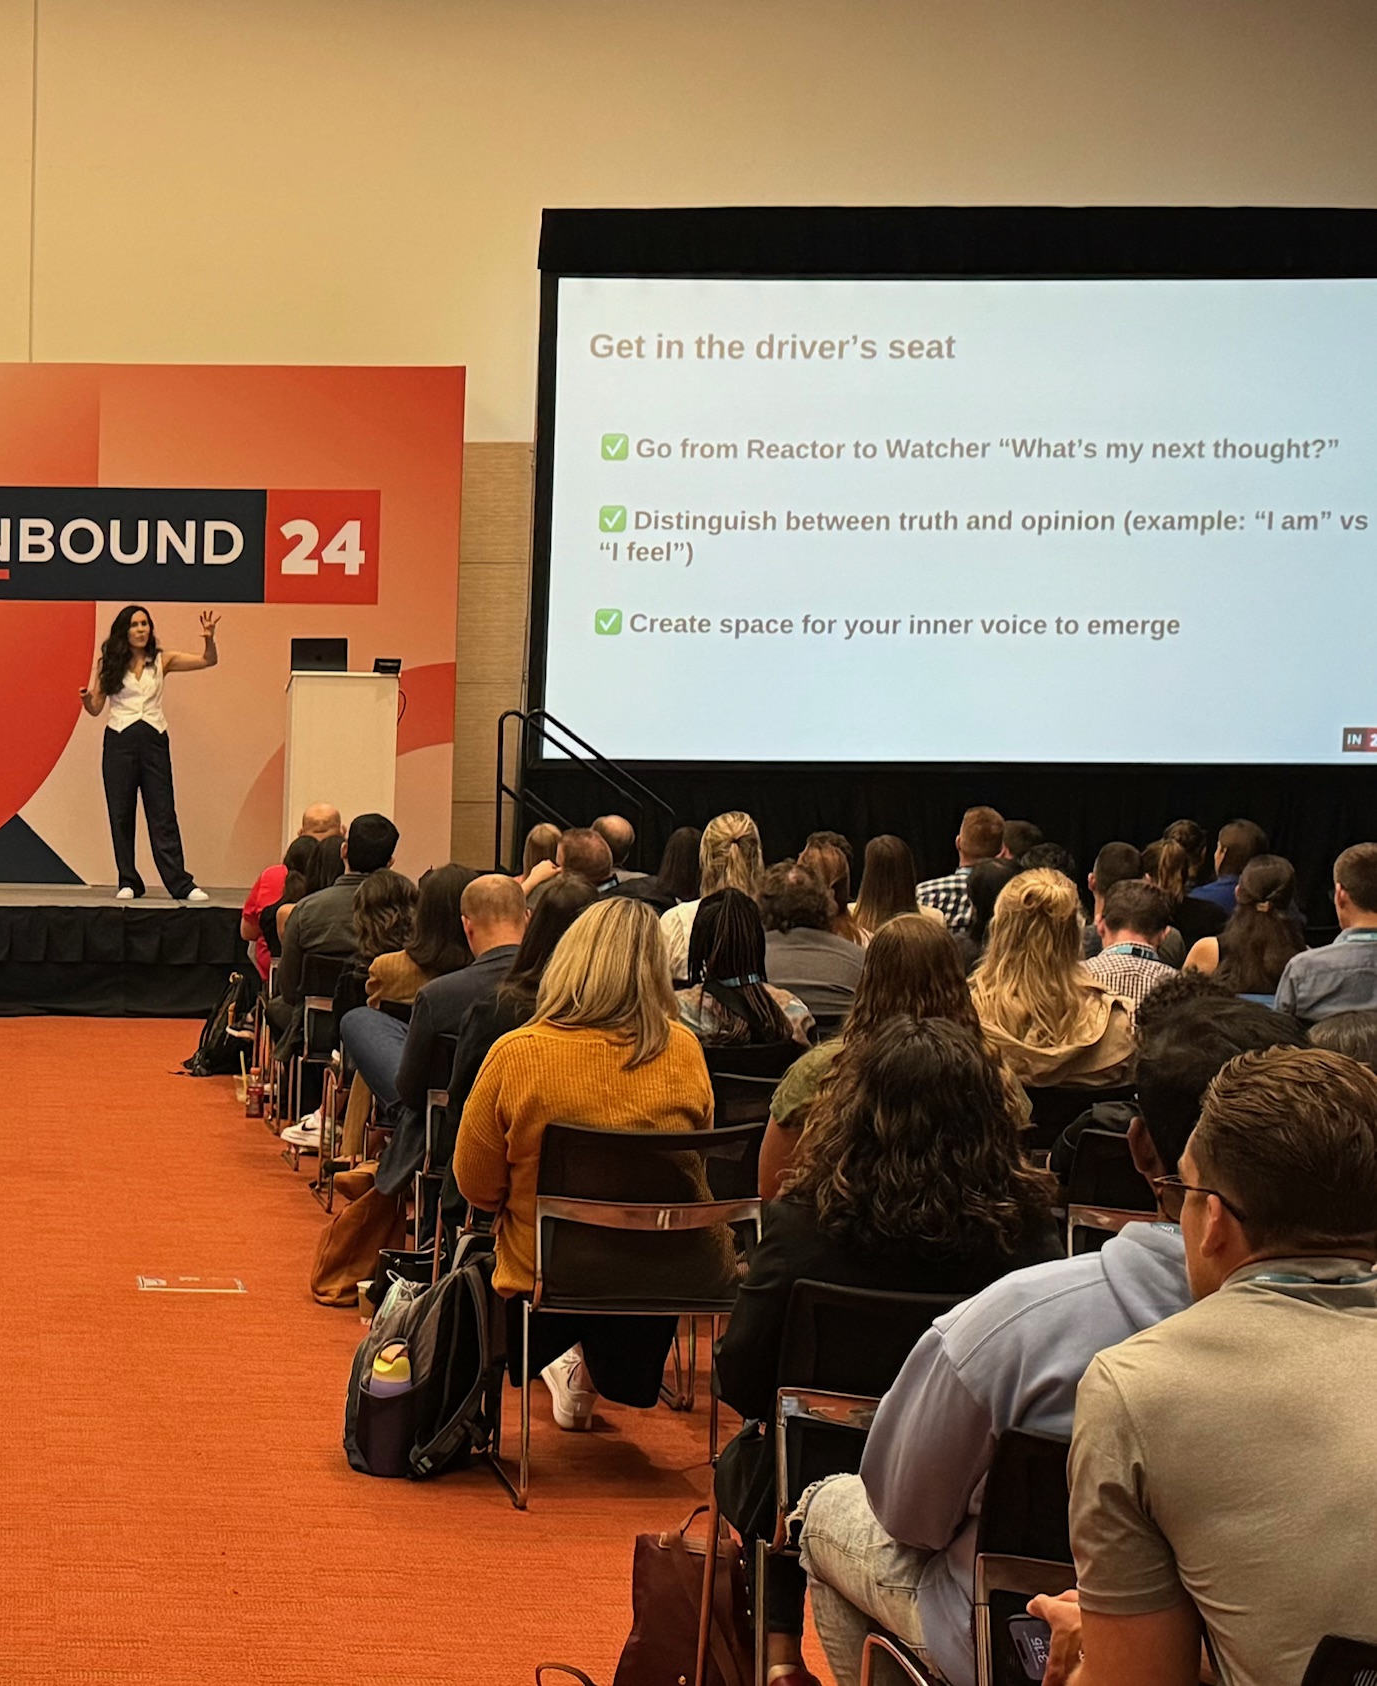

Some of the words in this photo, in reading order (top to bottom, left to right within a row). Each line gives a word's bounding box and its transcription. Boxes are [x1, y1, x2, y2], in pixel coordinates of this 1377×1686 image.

[589, 333, 646, 359] Get
[656, 333, 684, 360] in
[694, 333, 745, 360] the
[755, 333, 878, 360] driver’s
[888, 335, 957, 360] seat
[636, 438, 672, 459] Go
[680, 437, 738, 459] from
[747, 439, 846, 460] Reactor
[852, 440, 878, 459] to
[885, 437, 991, 459] Watcher
[999, 437, 1098, 459] “What’s
[1106, 442, 1144, 464] my
[1151, 439, 1206, 459] next
[1212, 437, 1339, 465] thought?”
[634, 509, 777, 536] Distinguish
[785, 510, 891, 532] between
[898, 509, 958, 532] truth
[966, 509, 1013, 531] and
[1021, 509, 1115, 536] opinion
[1123, 509, 1245, 537] (example:
[1254, 510, 1274, 531] “I
[1281, 510, 1332, 531] am”
[1339, 514, 1369, 531] vs
[278, 518, 367, 577] 24
[599, 541, 619, 562] “I
[626, 541, 694, 568] feel”)
[629, 613, 712, 634] Create
[719, 618, 794, 640] space
[801, 613, 838, 635] for
[843, 619, 902, 641] your
[909, 614, 974, 635] inner
[980, 613, 1048, 635] voice
[1054, 616, 1080, 635] to
[1087, 619, 1181, 641] emerge
[1346, 732, 1363, 746] IN
[1030, 1636, 1049, 1664] 3:15
